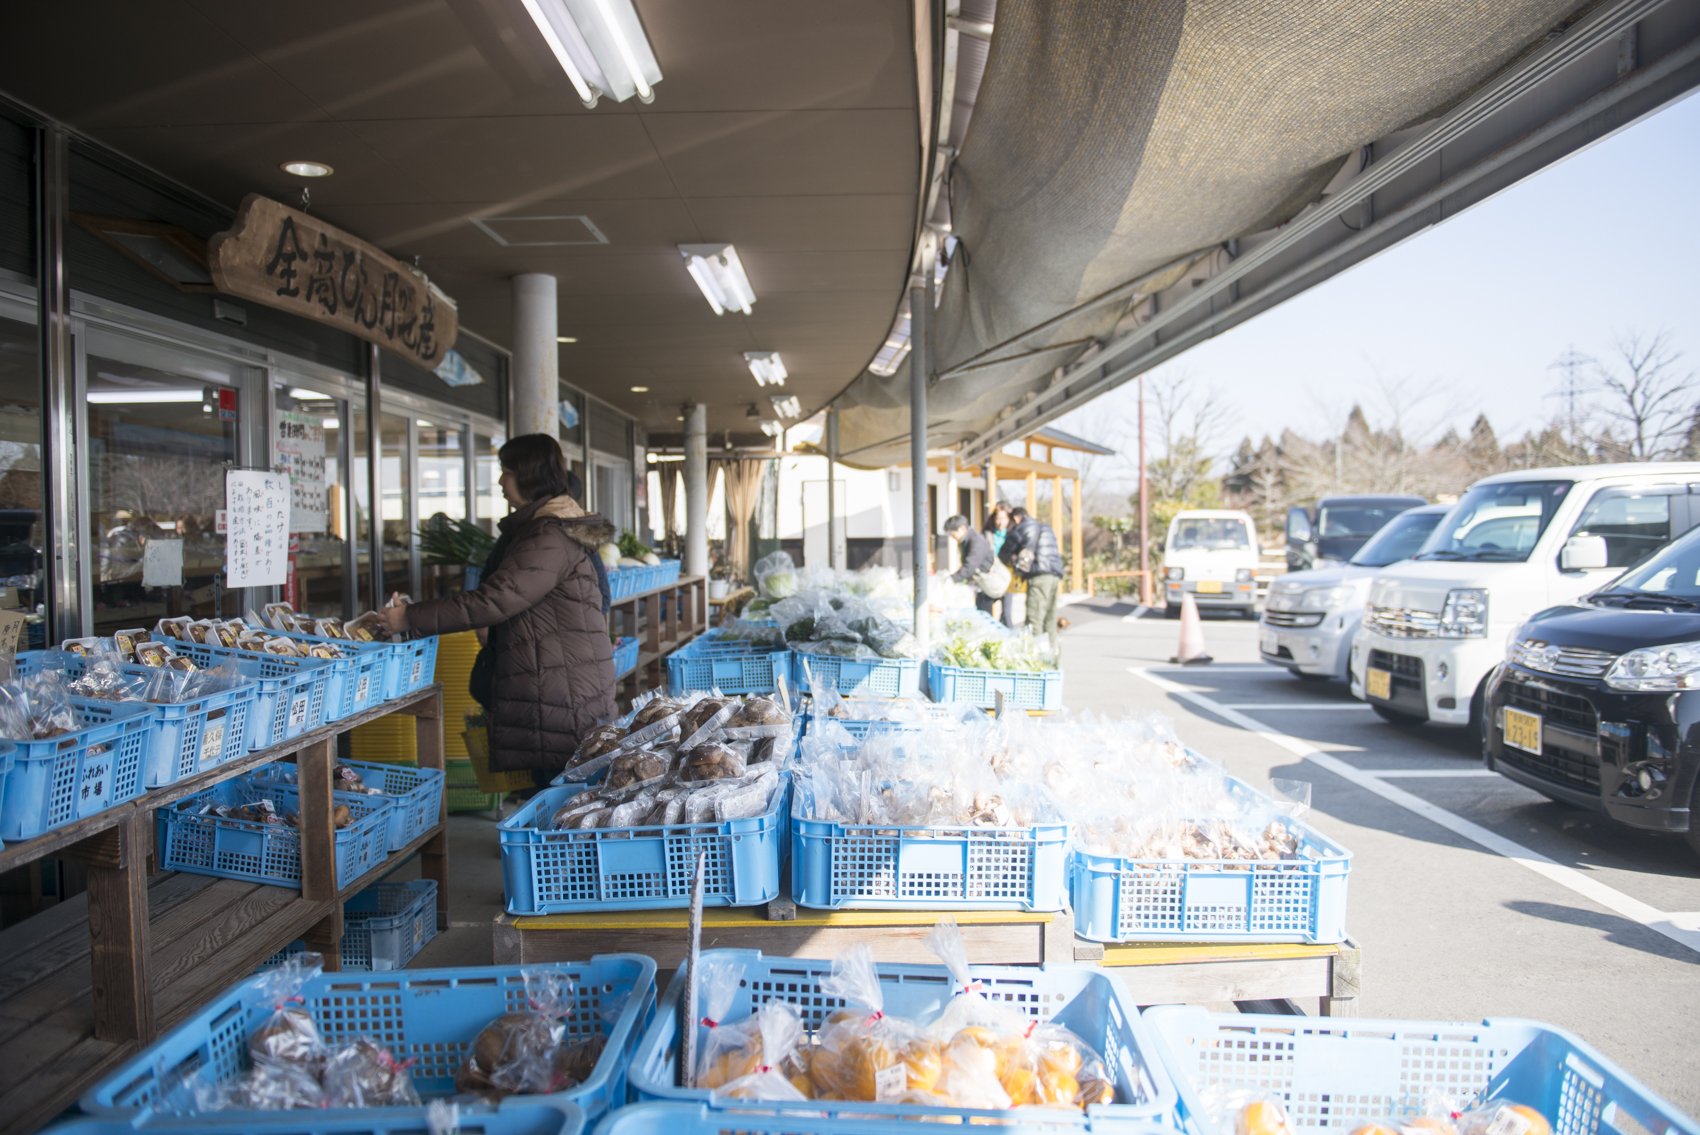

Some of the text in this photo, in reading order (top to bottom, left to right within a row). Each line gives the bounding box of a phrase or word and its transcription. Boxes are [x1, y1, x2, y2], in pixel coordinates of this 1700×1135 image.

[292, 700, 306, 716] 松田
[82, 764, 108, 782] ふれあい
[81, 781, 103, 800] 市場
